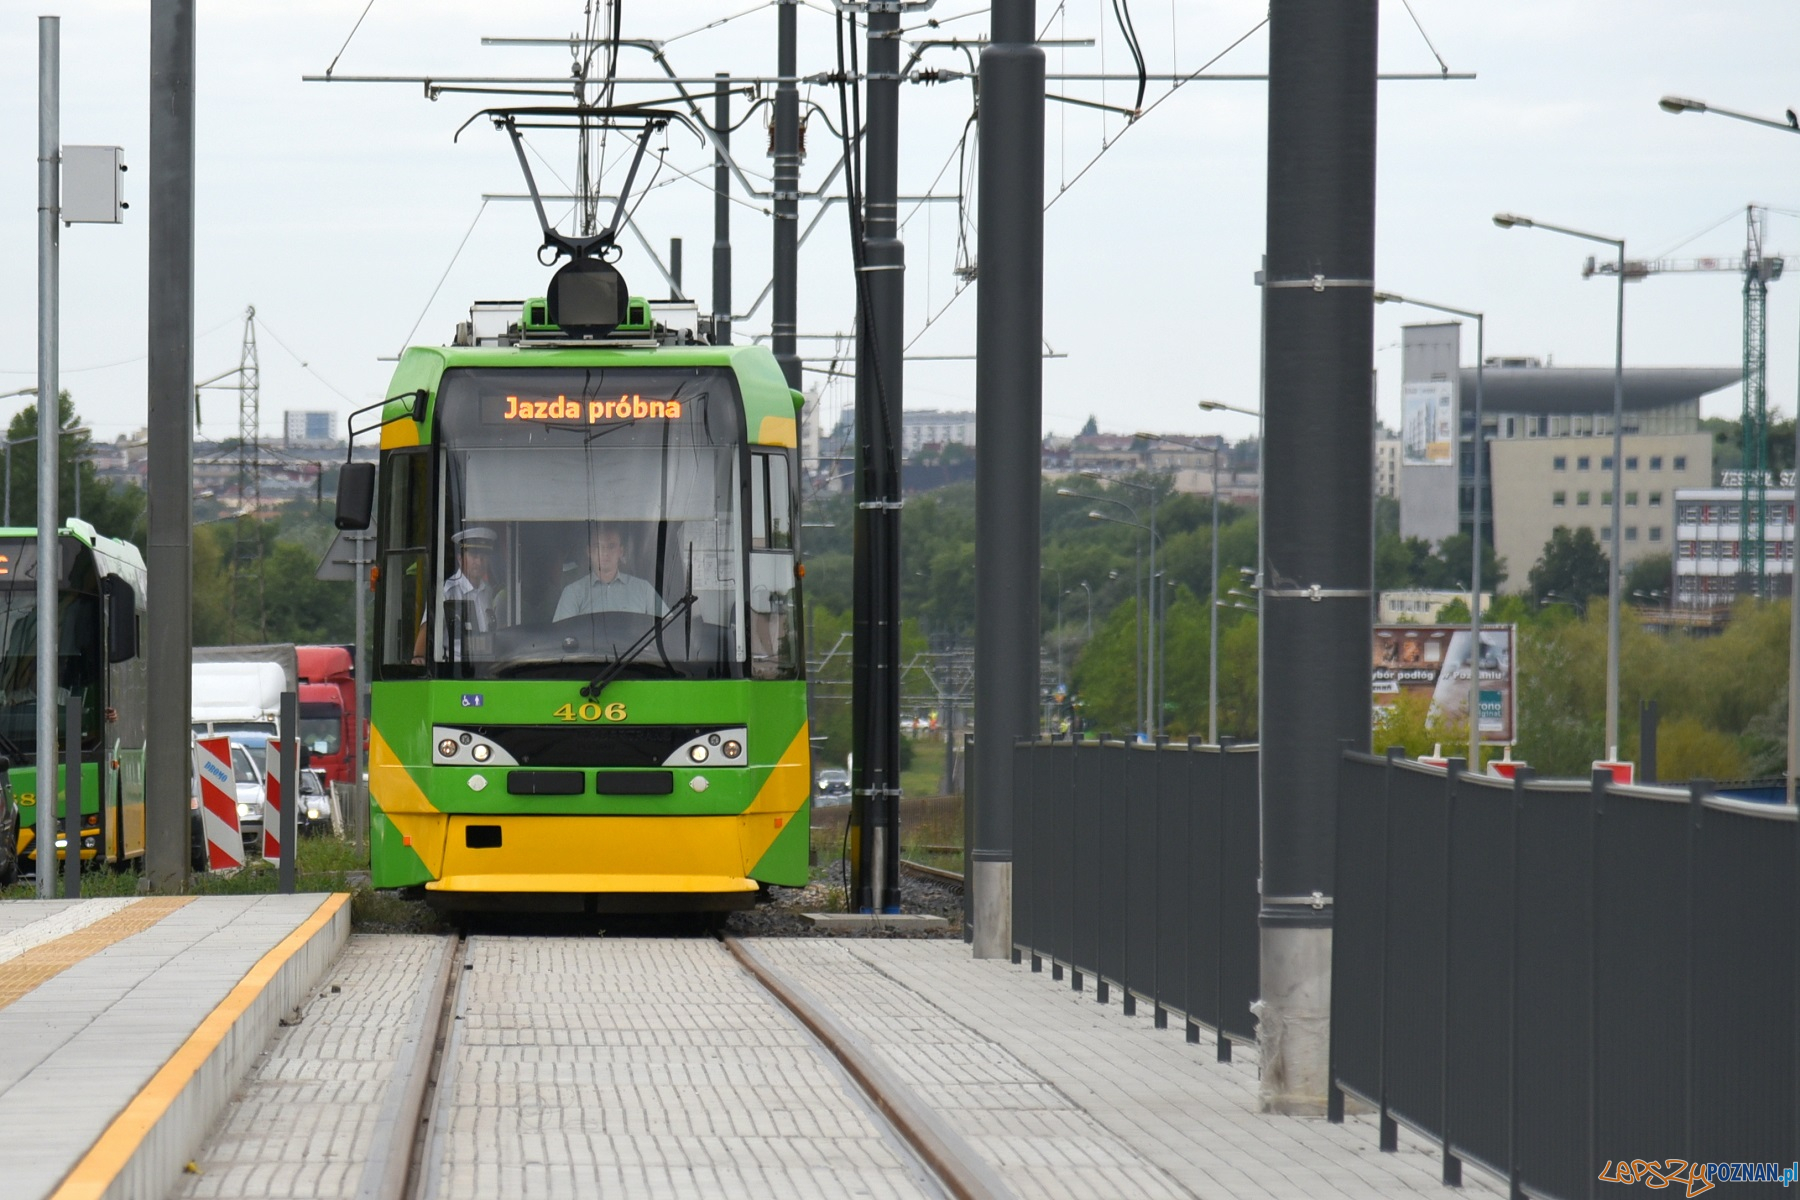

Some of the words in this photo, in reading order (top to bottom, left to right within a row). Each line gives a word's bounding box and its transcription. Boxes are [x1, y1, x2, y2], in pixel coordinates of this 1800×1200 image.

[504, 395, 580, 419] Jazda
[588, 394, 682, 424] próbna
[1397, 670, 1434, 682] podłóg
[1453, 671, 1502, 680] Pozaniu
[552, 702, 627, 722] 406
[203, 760, 228, 783] DROMO
